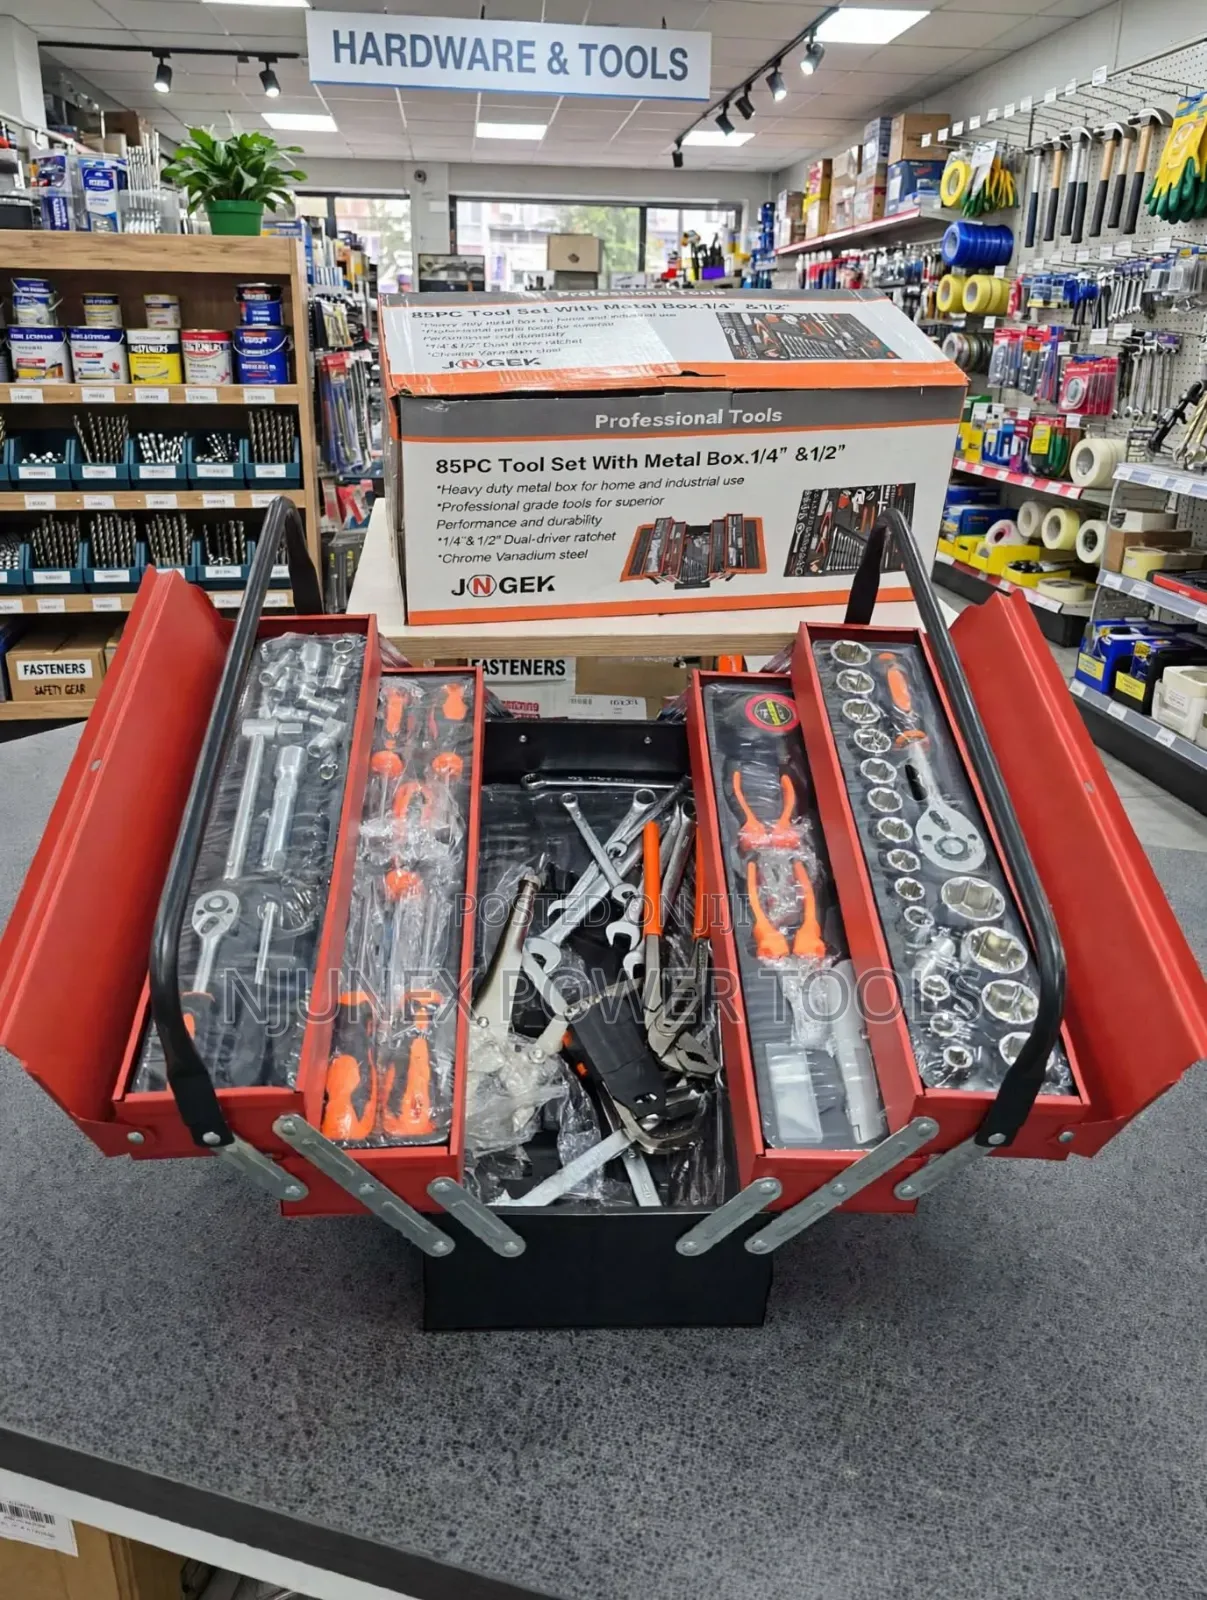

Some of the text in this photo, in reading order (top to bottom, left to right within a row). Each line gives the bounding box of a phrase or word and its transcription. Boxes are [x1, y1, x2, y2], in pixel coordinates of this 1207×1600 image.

[332, 29, 689, 81] HARDWARE & TOOLS
[411, 311, 463, 319] 85PC
[467, 309, 511, 317] Tool
[554, 304, 598, 313] With
[595, 407, 783, 429] Professional Tools
[435, 458, 492, 474] 85PC
[498, 456, 545, 473] Tool
[551, 455, 587, 471] Set
[592, 453, 638, 470] With
[644, 451, 701, 468] Metal
[486, 483, 513, 496] duty
[516, 481, 552, 493] metal
[555, 481, 578, 492] box
[581, 480, 598, 491] for
[600, 480, 635, 491] home
[638, 478, 663, 489] and
[665, 476, 720, 488] industrial
[723, 476, 745, 486] use
[523, 499, 559, 512] grade
[562, 498, 592, 509] tools
[595, 497, 613, 508] for
[615, 496, 665, 508] superior
[436, 514, 602, 530] Performance and durability
[504, 533, 571, 545] Dual-driver
[573, 531, 617, 542] ratchet
[496, 550, 556, 562] Vanadium
[559, 549, 589, 560] steel
[23, 663, 86, 676] FASTENERS
[34, 683, 86, 696] SAFETY GEAR
